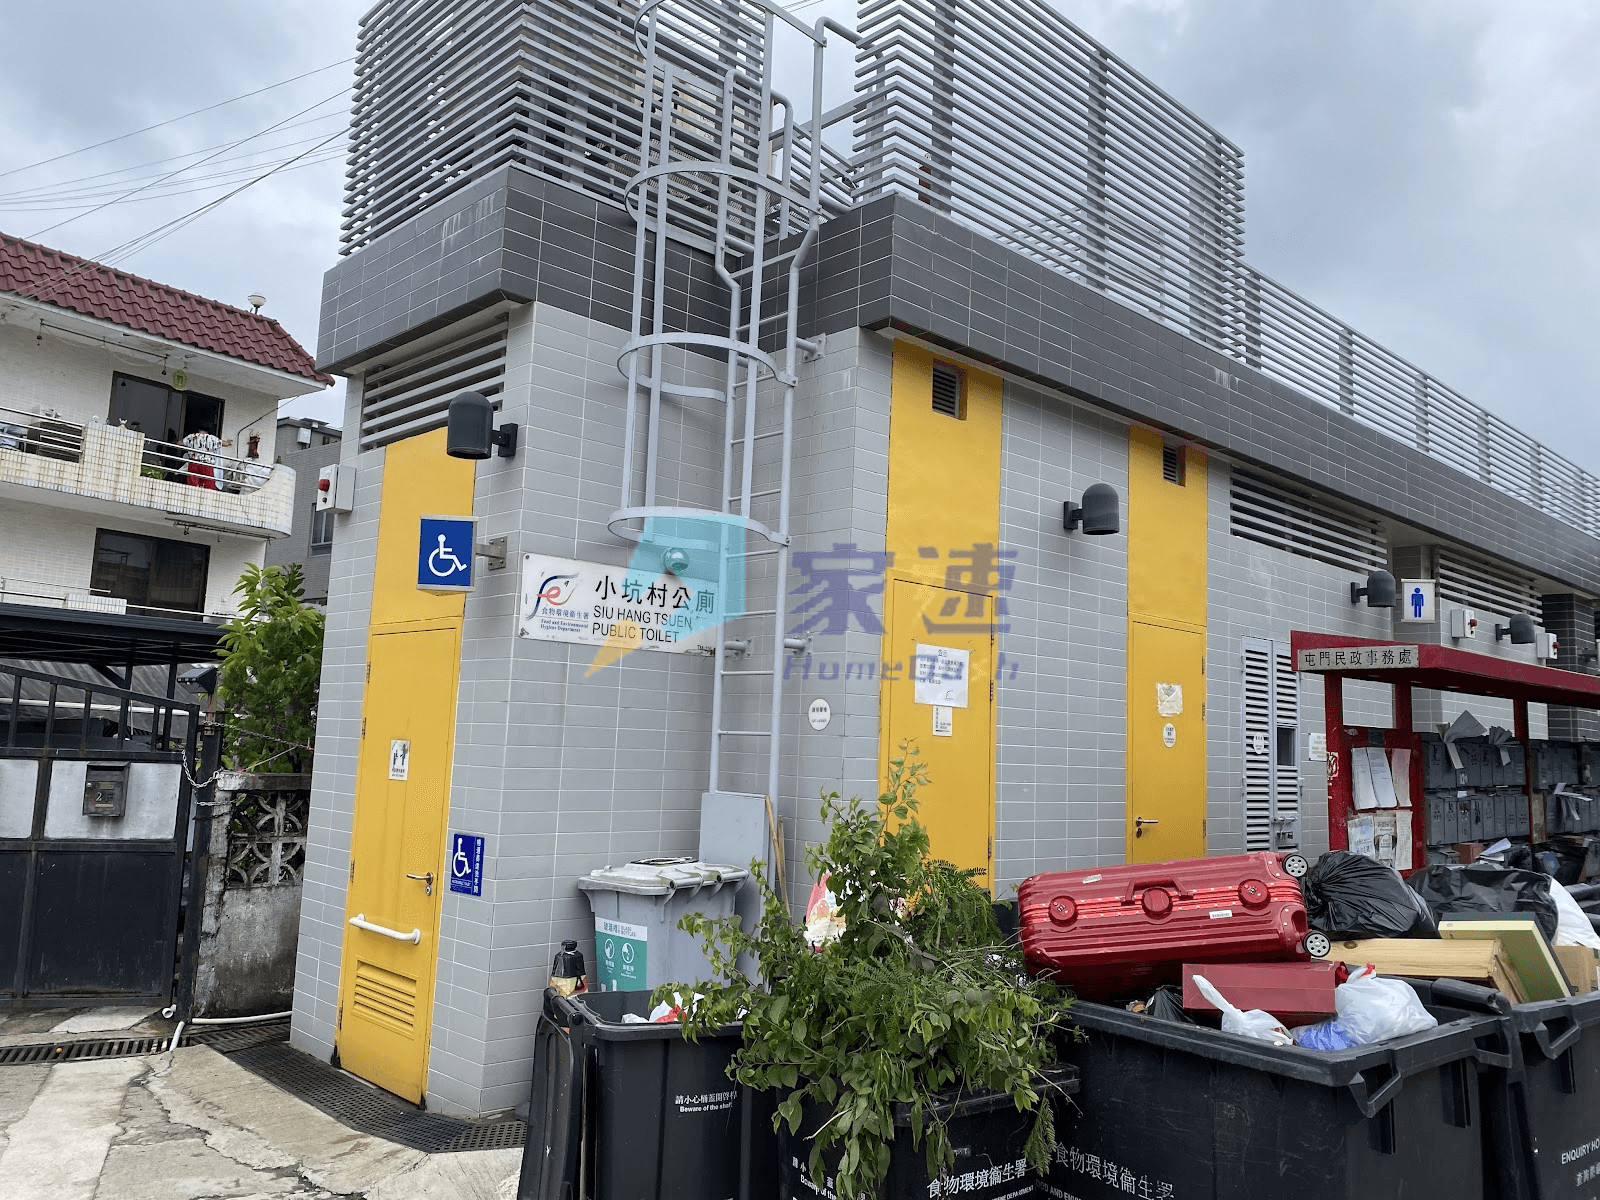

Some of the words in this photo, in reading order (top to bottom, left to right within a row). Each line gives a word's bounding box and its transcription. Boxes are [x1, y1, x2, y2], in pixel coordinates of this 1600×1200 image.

[595, 575, 715, 614] 小坑村公廁
[593, 605, 614, 620] SIU
[617, 608, 651, 623] HANG
[654, 612, 693, 630] TSUEN
[592, 623, 636, 639] PUBLIC
[639, 628, 679, 643] TOILET
[1305, 649, 1412, 667] 屯門民政事務處
[1561, 1142, 1591, 1165] ENQUIRY
